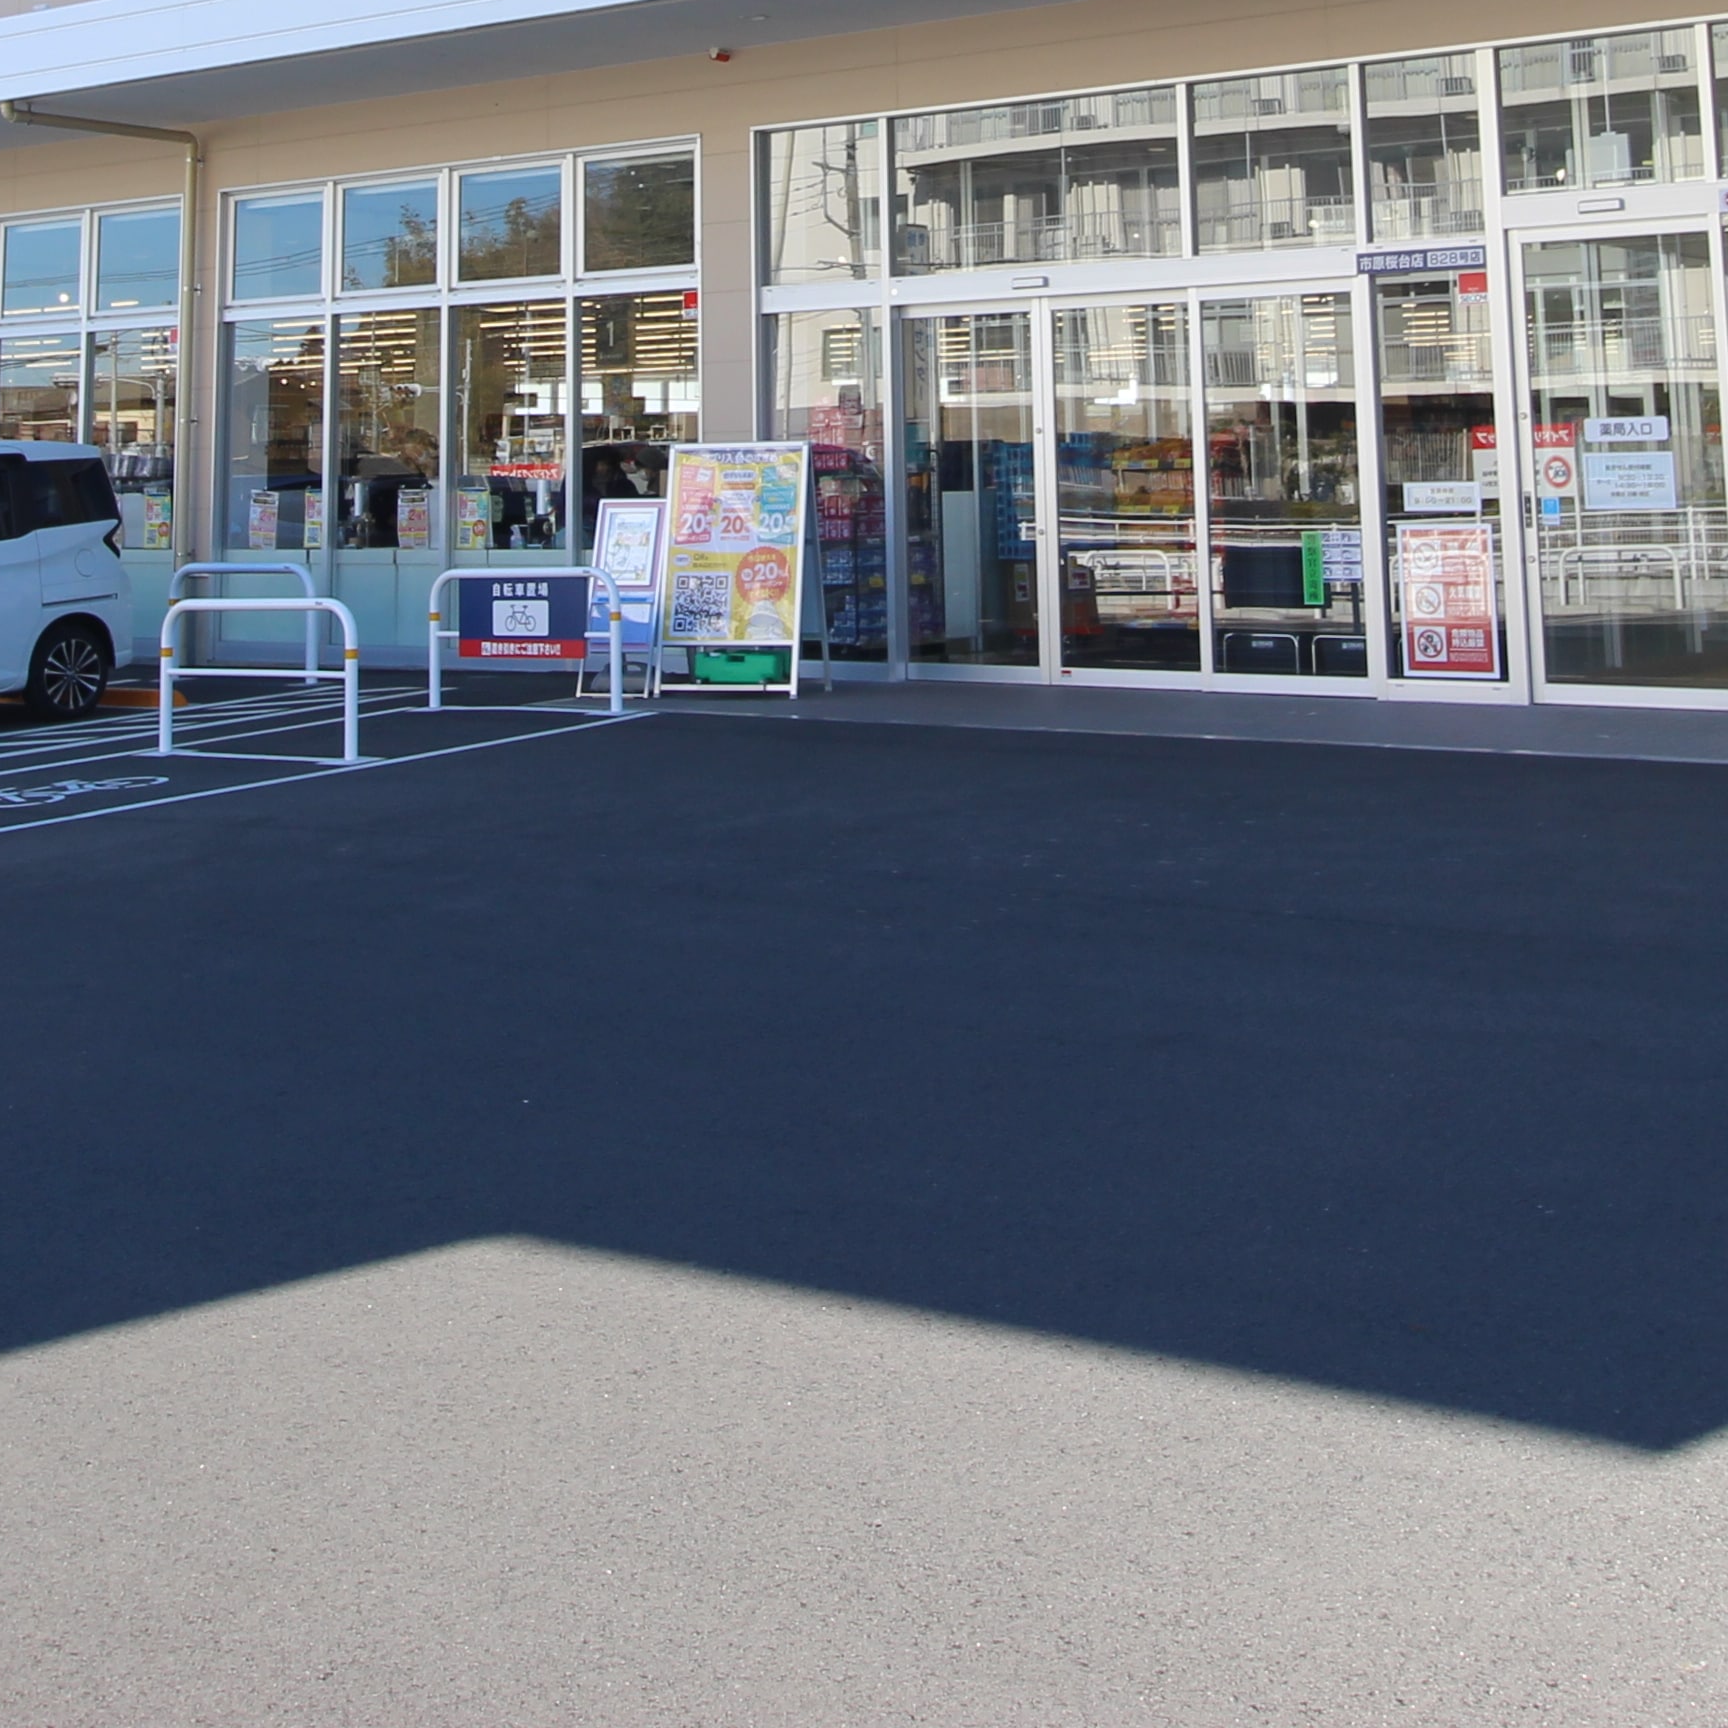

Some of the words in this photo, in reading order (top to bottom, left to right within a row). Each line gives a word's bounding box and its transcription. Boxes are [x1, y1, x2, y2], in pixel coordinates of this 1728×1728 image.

[1360, 254, 1424, 270] 市原桜台店
[1600, 422, 1653, 436] 薬局入口
[492, 582, 549, 597] 自転車置場
